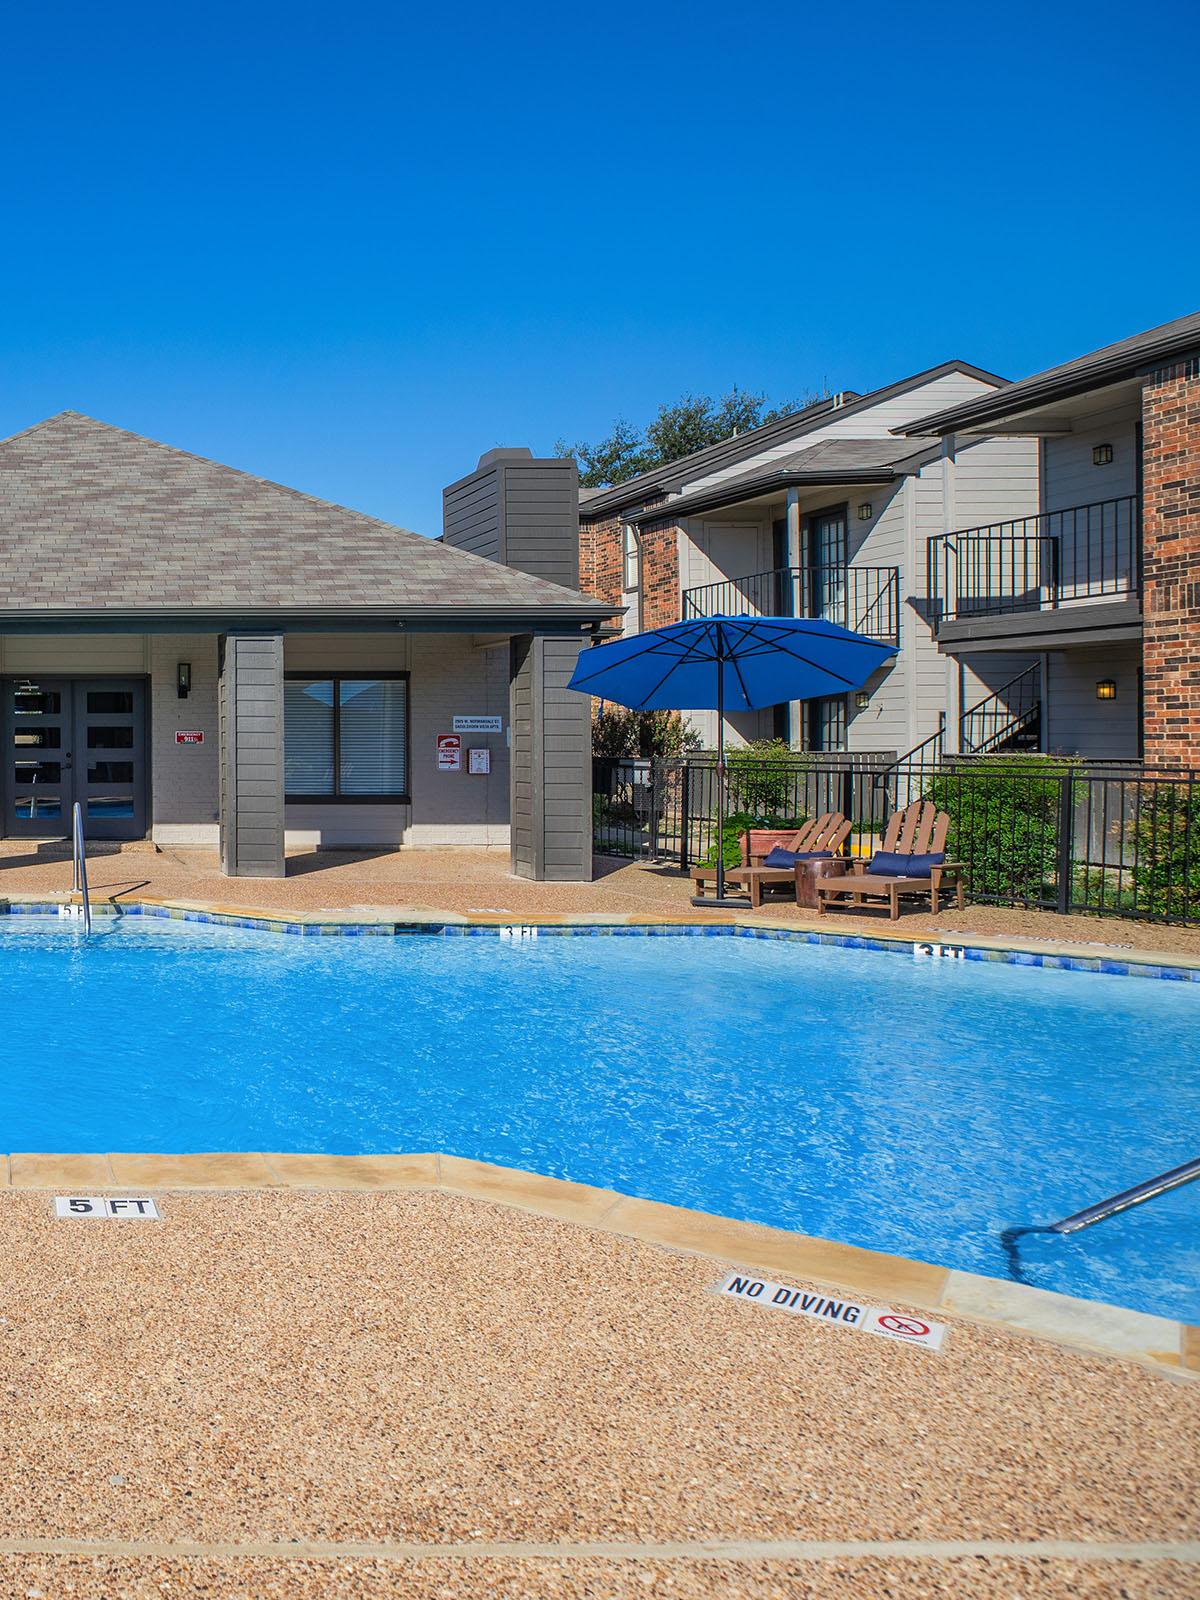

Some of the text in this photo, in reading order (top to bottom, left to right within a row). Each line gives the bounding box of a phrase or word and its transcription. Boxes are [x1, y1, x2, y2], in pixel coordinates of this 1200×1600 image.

[505, 925, 535, 936] 3 FT
[919, 944, 964, 959] 3 FT
[69, 1199, 149, 1214] 5 FT
[728, 1276, 861, 1324] NO DIVING
